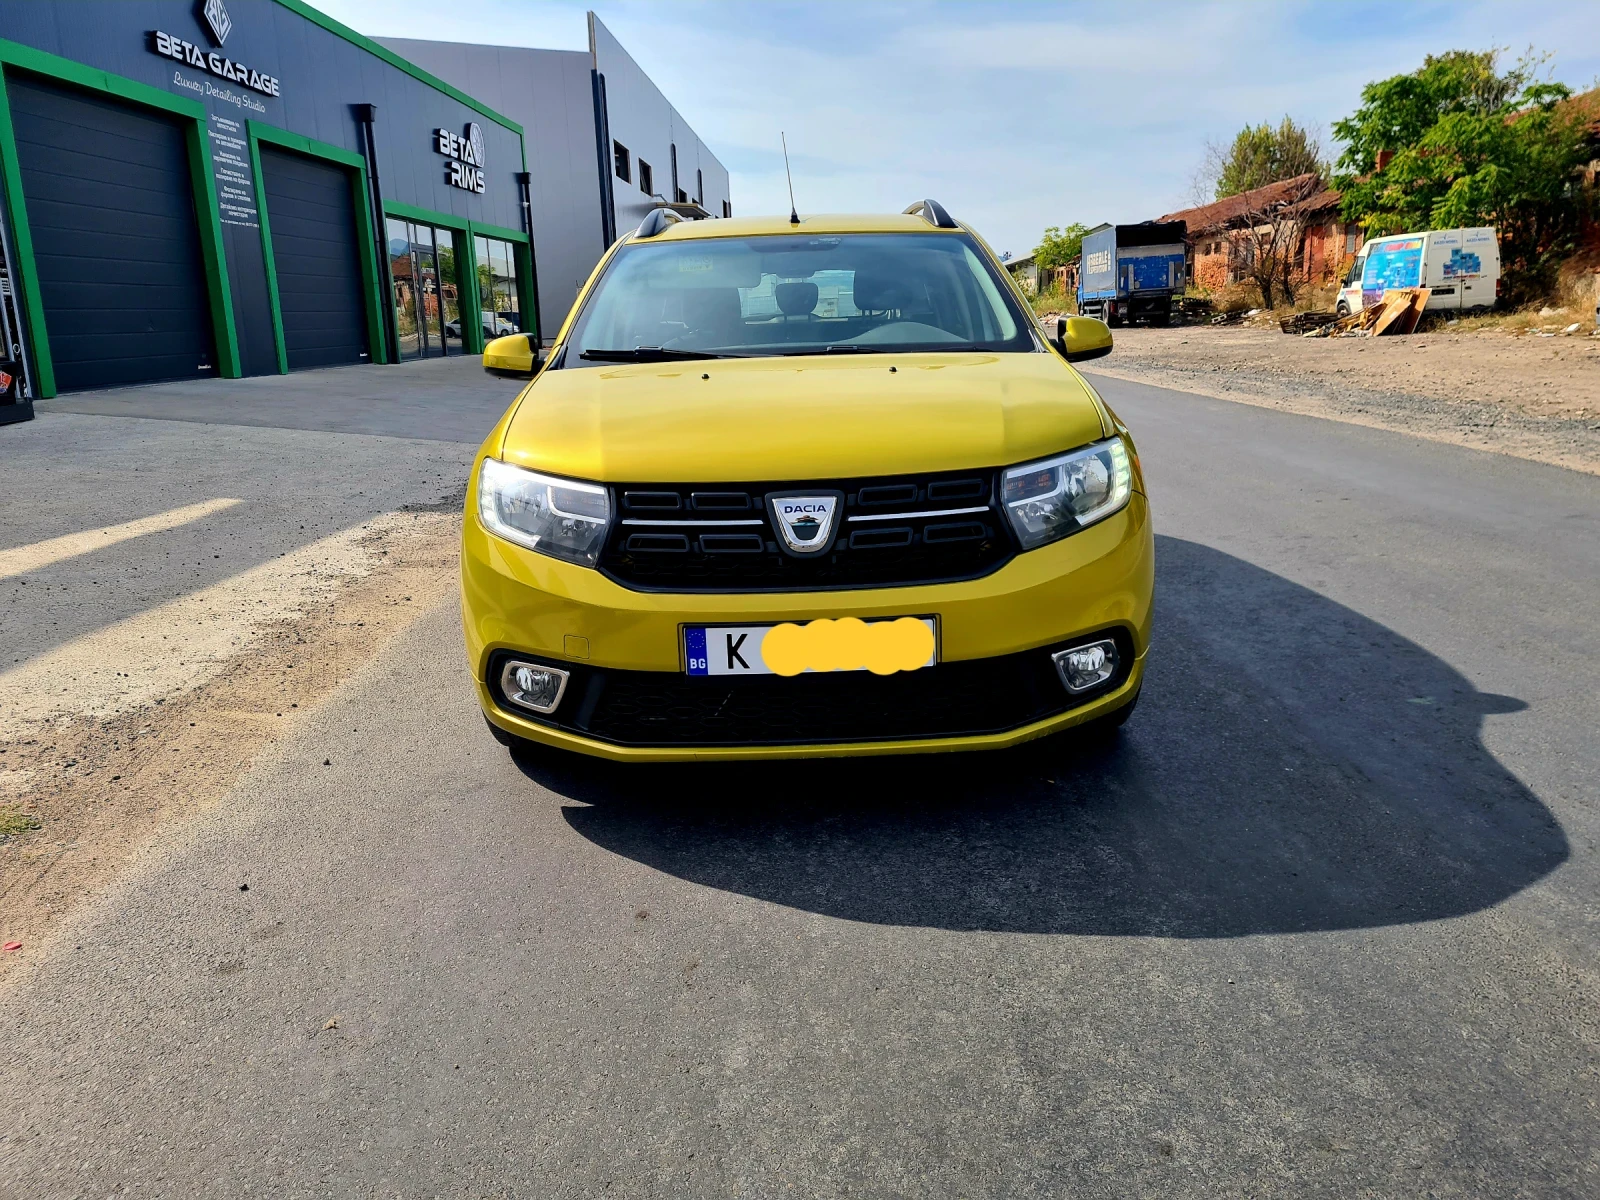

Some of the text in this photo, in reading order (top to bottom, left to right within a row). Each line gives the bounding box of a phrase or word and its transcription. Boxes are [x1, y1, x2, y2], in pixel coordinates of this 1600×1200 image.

[156, 30, 280, 97] BETA GARAGE
[173, 71, 266, 113] Luxury Detailing Studio
[439, 128, 476, 165] BETA
[451, 161, 486, 194] RIMS
[784, 504, 827, 514] DACIA
[689, 658, 706, 669] BG
[726, 633, 751, 670] K
